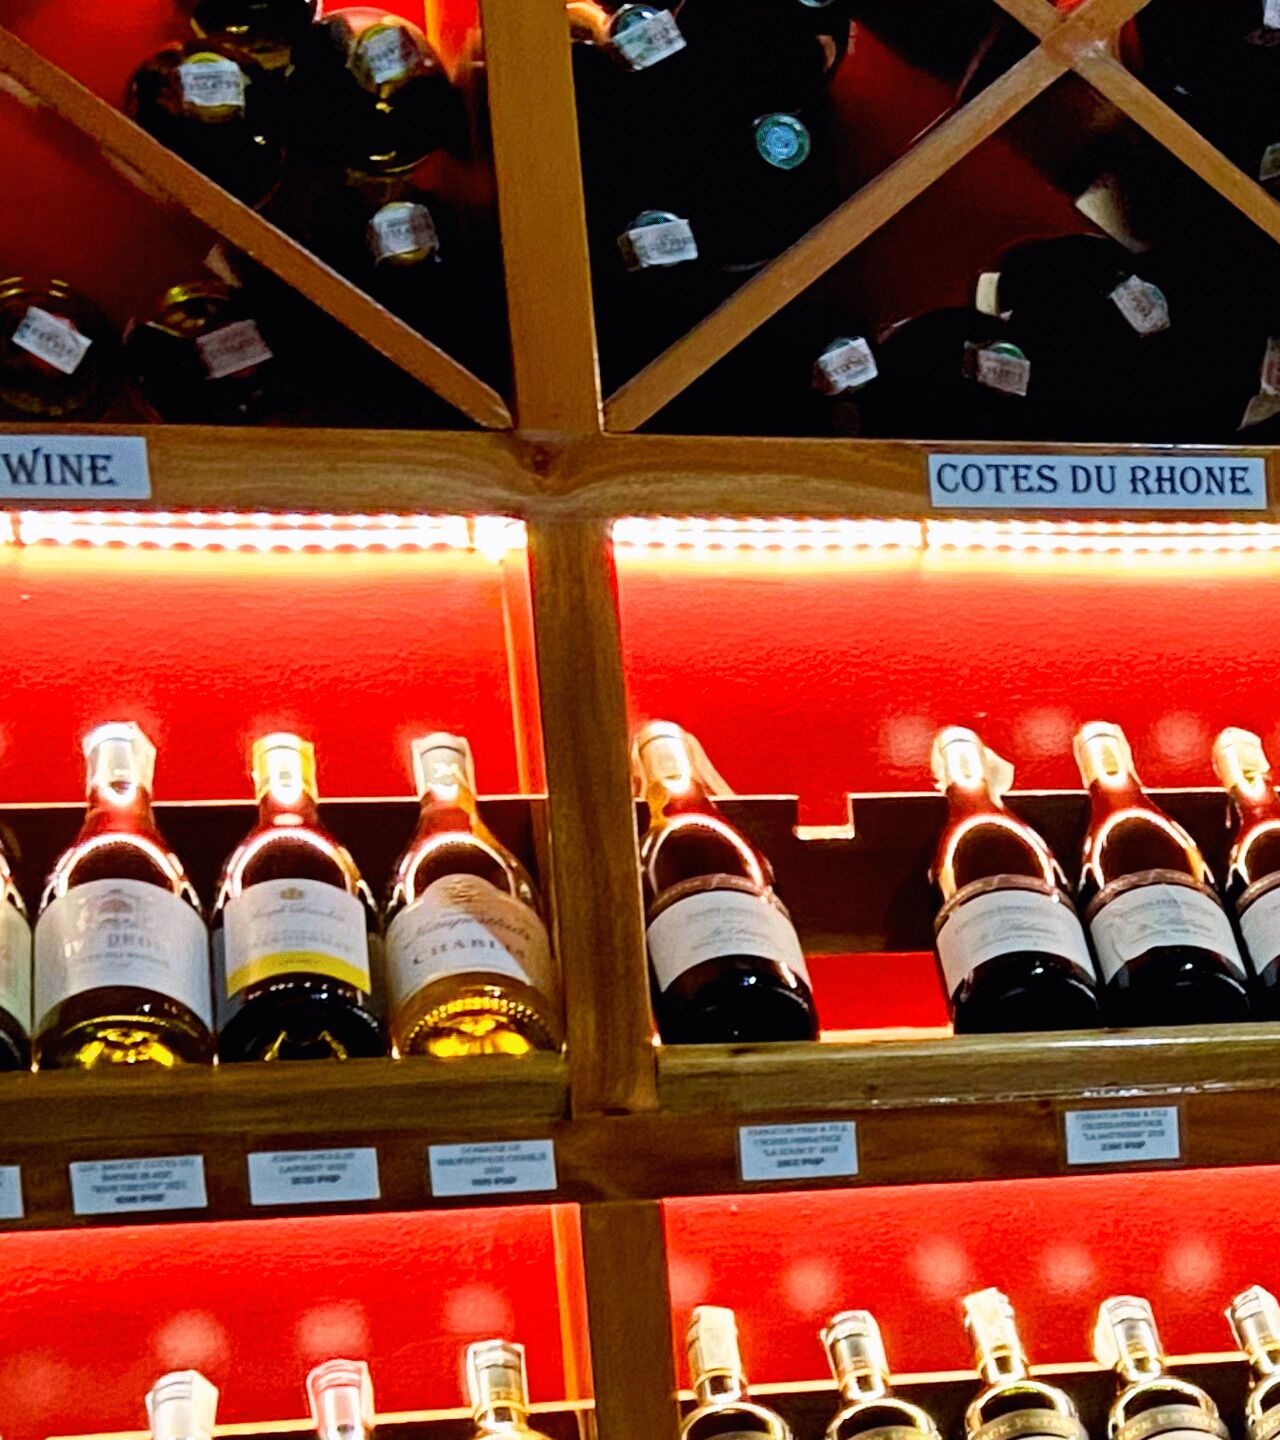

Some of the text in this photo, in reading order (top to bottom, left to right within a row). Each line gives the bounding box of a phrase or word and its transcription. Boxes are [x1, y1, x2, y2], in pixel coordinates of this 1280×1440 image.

[2, 447, 117, 486] WINE
[937, 462, 1252, 496] COTES DU RHONE
